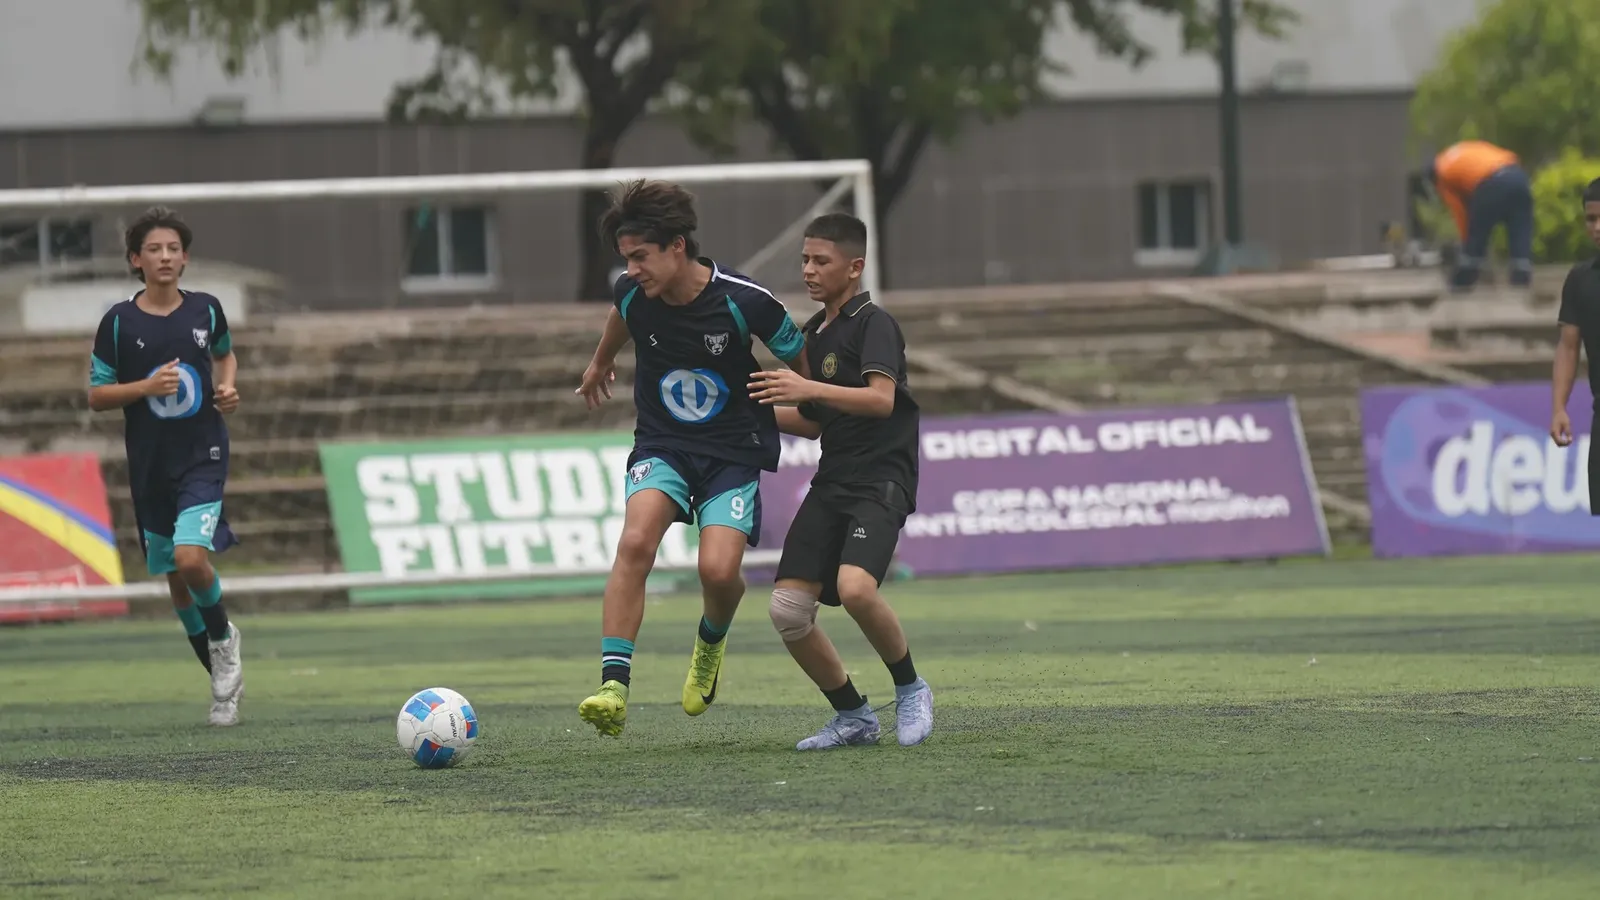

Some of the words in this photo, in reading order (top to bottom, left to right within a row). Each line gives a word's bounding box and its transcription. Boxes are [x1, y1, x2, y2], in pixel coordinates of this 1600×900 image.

[922, 425, 1096, 461] DIGITAL
[1098, 413, 1272, 451] OFICIAL
[730, 495, 745, 520] 9
[953, 486, 1051, 515] COPA
[1052, 476, 1233, 508] NACIONAL
[905, 496, 1167, 538] INTERCOLEGIAL
